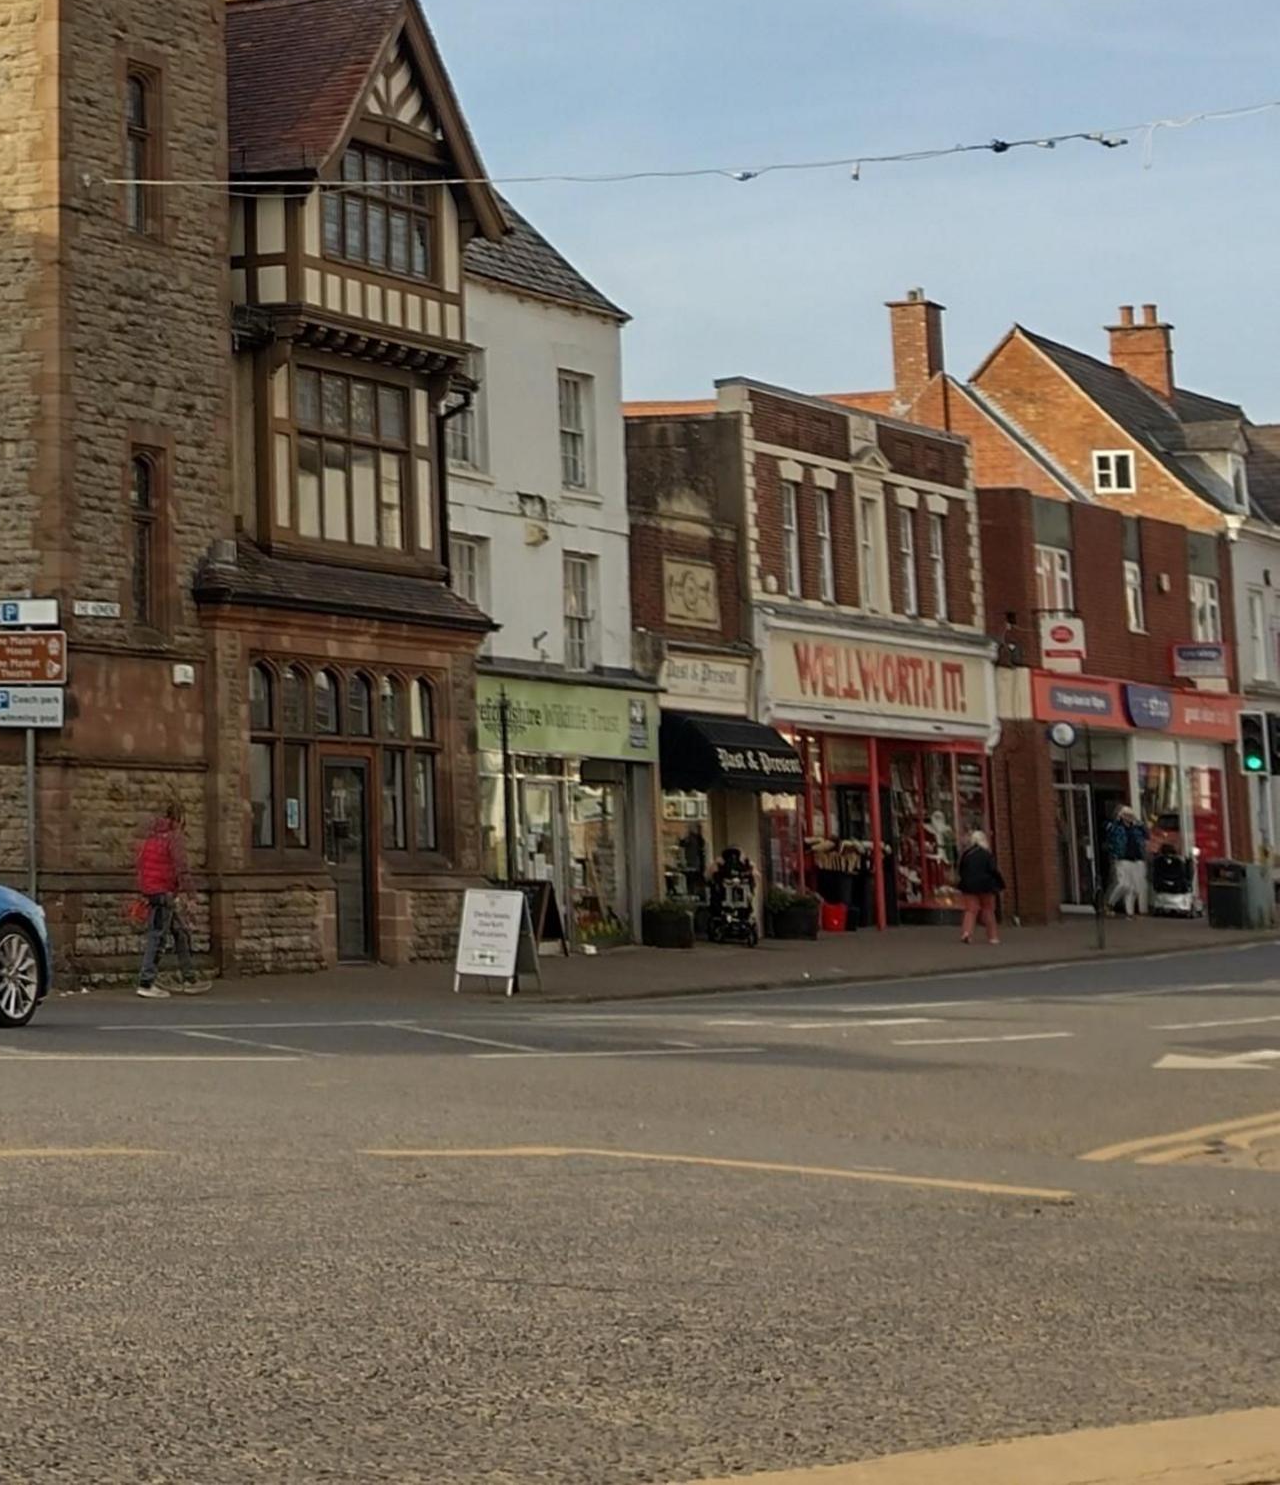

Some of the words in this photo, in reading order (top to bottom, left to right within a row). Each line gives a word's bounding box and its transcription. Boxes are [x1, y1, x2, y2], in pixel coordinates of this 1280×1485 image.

[10, 659, 41, 668] Market
[701, 663, 737, 685] Present
[792, 641, 938, 710] WELLWORTH
[941, 661, 968, 713] IT!
[11, 694, 39, 705] Coach
[40, 694, 60, 706] park
[40, 714, 60, 724] pool
[588, 706, 621, 733] Trust
[716, 747, 747, 772] Past
[747, 750, 760, 771] &
[758, 750, 803, 775] Present
